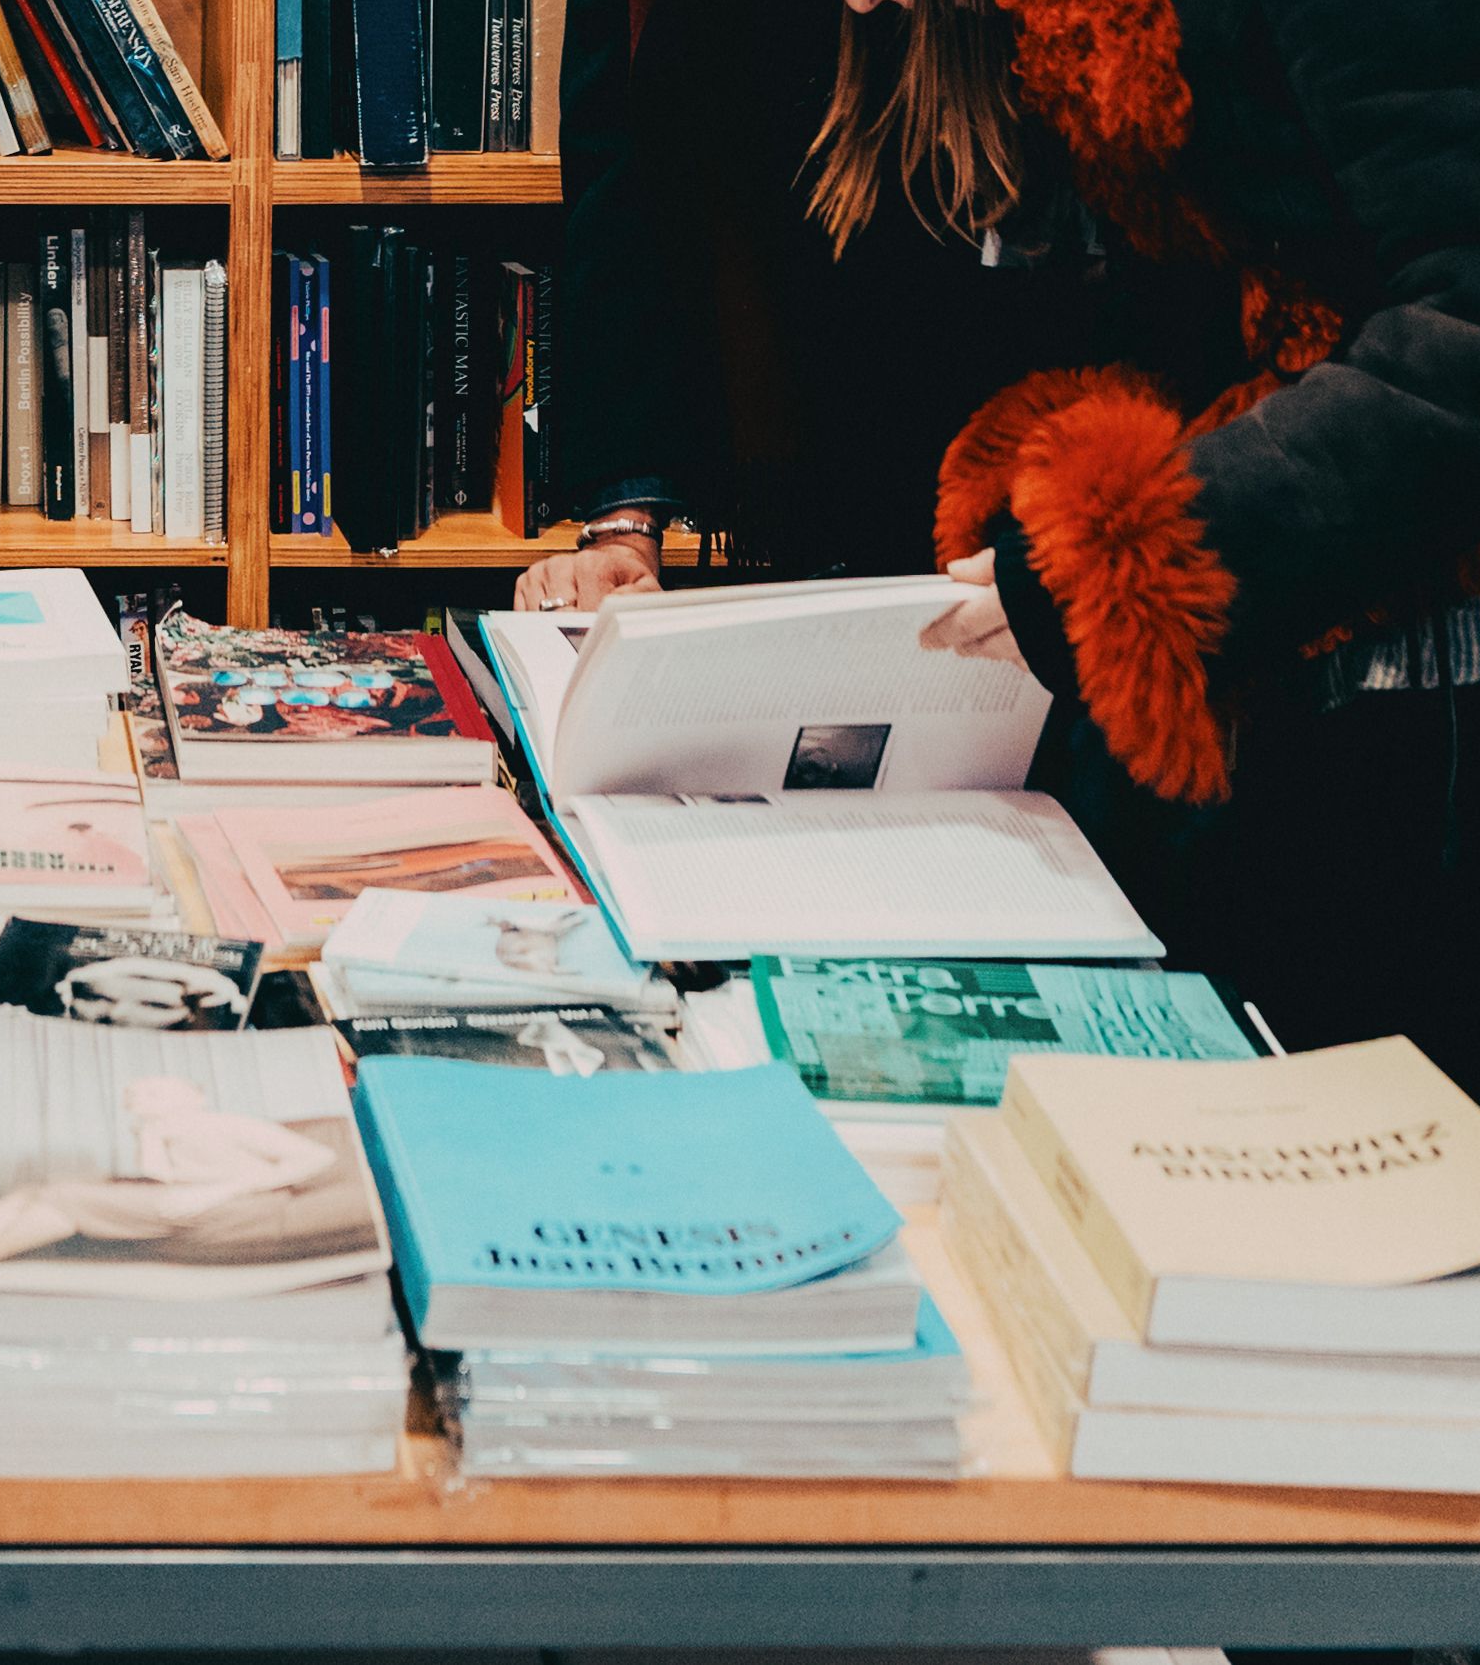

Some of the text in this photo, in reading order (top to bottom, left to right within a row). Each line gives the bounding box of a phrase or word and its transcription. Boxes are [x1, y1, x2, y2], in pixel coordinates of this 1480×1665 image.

[511, 17, 524, 85] Twelvetrees
[512, 89, 523, 120] Press
[47, 236, 59, 289] Linder
[17, 292, 32, 410] Berlin Possibility
[455, 355, 468, 395] MAN
